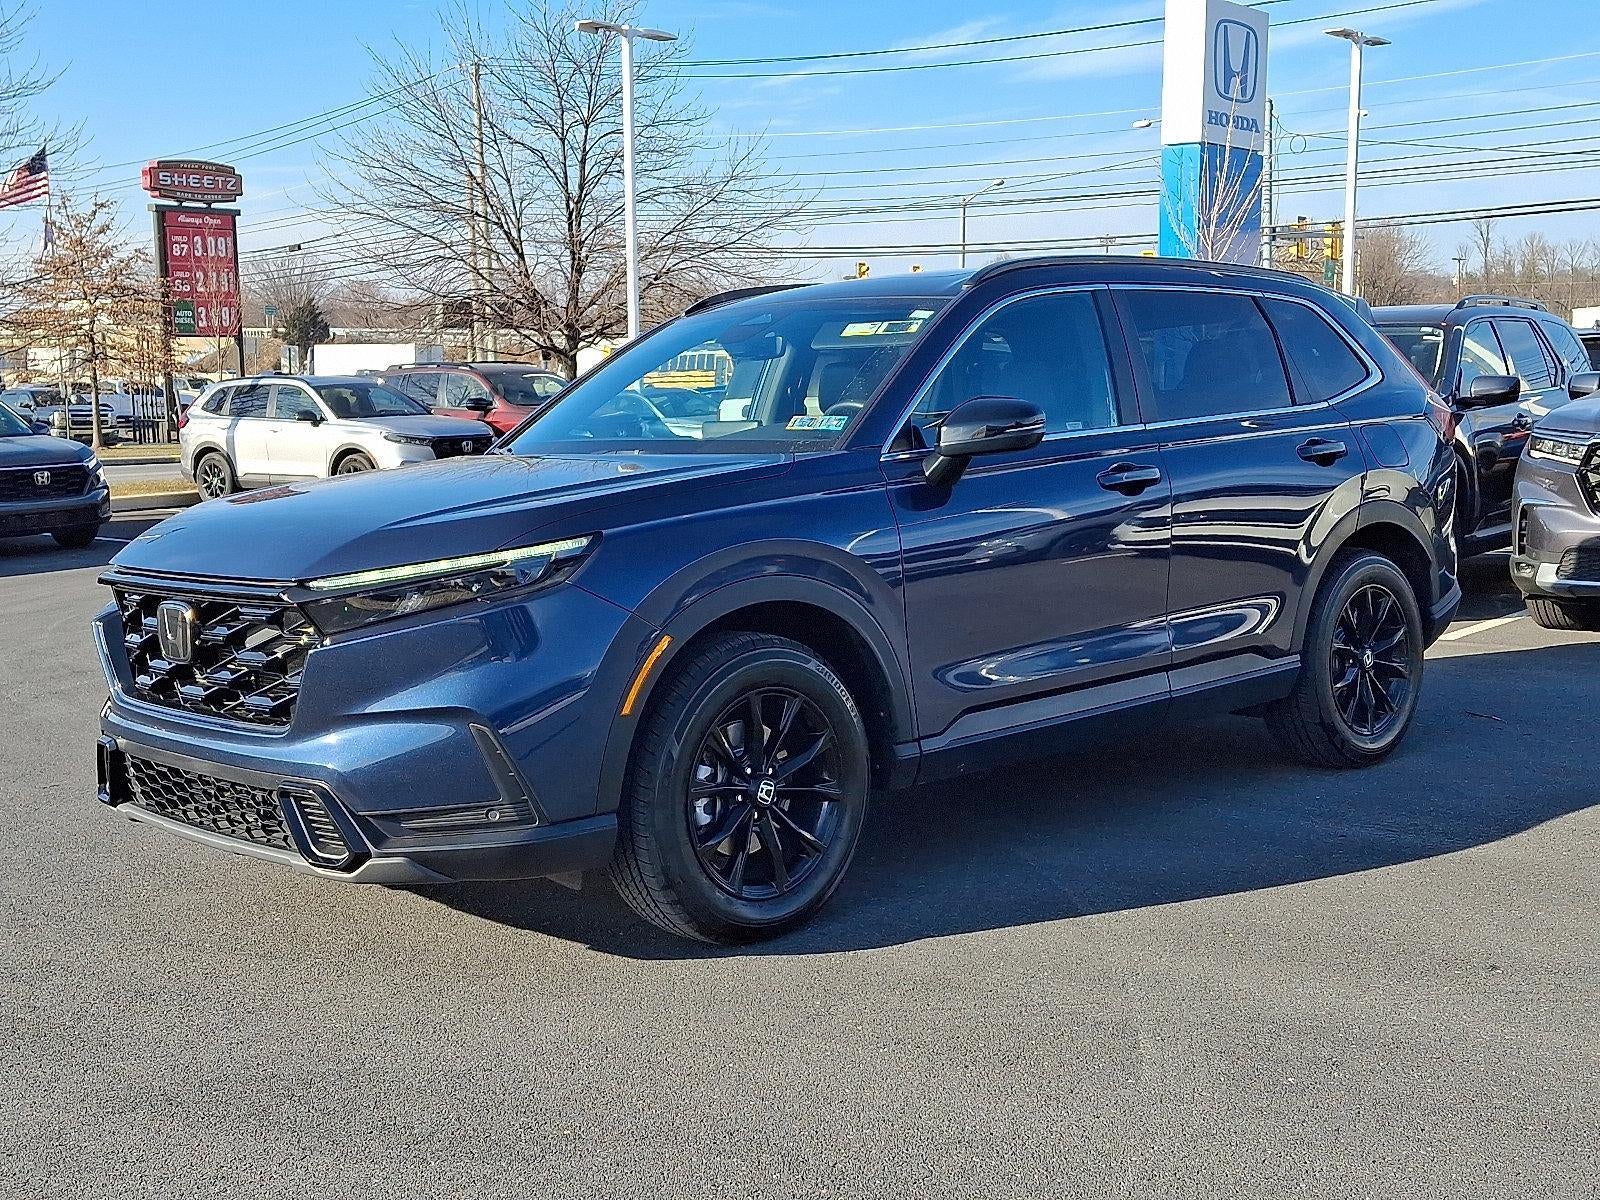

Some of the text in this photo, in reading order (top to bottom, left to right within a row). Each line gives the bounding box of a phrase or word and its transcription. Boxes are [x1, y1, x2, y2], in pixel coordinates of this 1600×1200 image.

[1207, 109, 1260, 133] HONDA
[159, 171, 237, 190] SHEETZ
[177, 214, 221, 226] Always Open
[172, 243, 189, 257] 87
